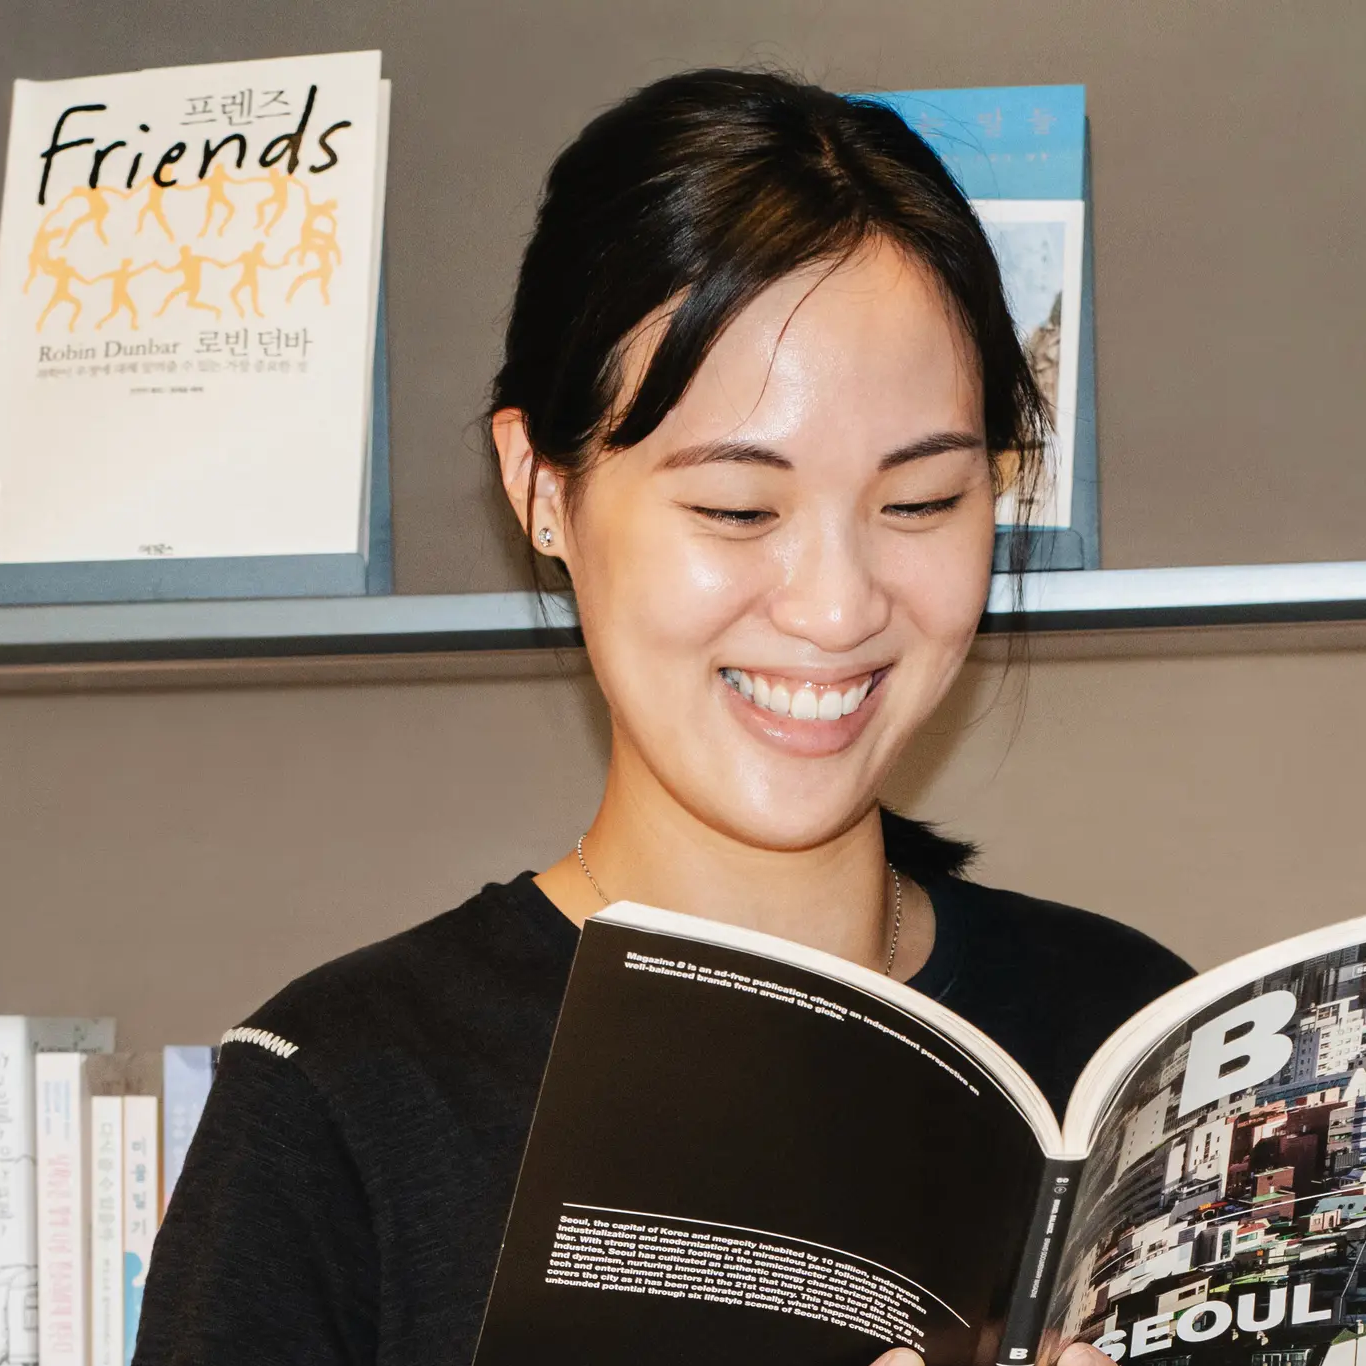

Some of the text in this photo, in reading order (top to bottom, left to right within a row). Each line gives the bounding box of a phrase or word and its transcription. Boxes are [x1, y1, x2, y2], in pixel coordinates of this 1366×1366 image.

[179, 87, 292, 127] 프렌즈
[36, 84, 352, 206] Friends
[38, 327, 314, 364] Robin Dunbar 로빈 던바
[624, 961, 845, 1022] well-balanced brands from around the globe.
[627, 952, 675, 966] Magazine
[687, 962, 697, 972] is
[699, 966, 713, 974] an
[713, 970, 751, 984] ad-free
[751, 978, 809, 1000] publication
[809, 996, 849, 1016] offering
[849, 1010, 863, 1020] an
[863, 1016, 921, 1050] independent
[921, 1048, 969, 1086] perspective
[969, 1084, 981, 1098] on
[1178, 990, 1298, 1119] B
[559, 1216, 591, 1226] Seoul,
[593, 1220, 609, 1228] the
[611, 1224, 645, 1232] capital
[647, 1226, 659, 1234] of
[659, 1228, 689, 1238] Korea
[711, 1236, 757, 1250] megacity
[759, 1242, 805, 1258] inhabited
[807, 1254, 819, 1262] by
[821, 1258, 833, 1266] 10
[835, 1262, 869, 1278] million,
[871, 1274, 919, 1302] underwent
[545, 1278, 893, 1344] unbounded potential through six lifestyle scenes of Seoul's top creatives.
[1092, 1282, 1332, 1363] SEOUL
[1009, 1347, 1029, 1360] B
